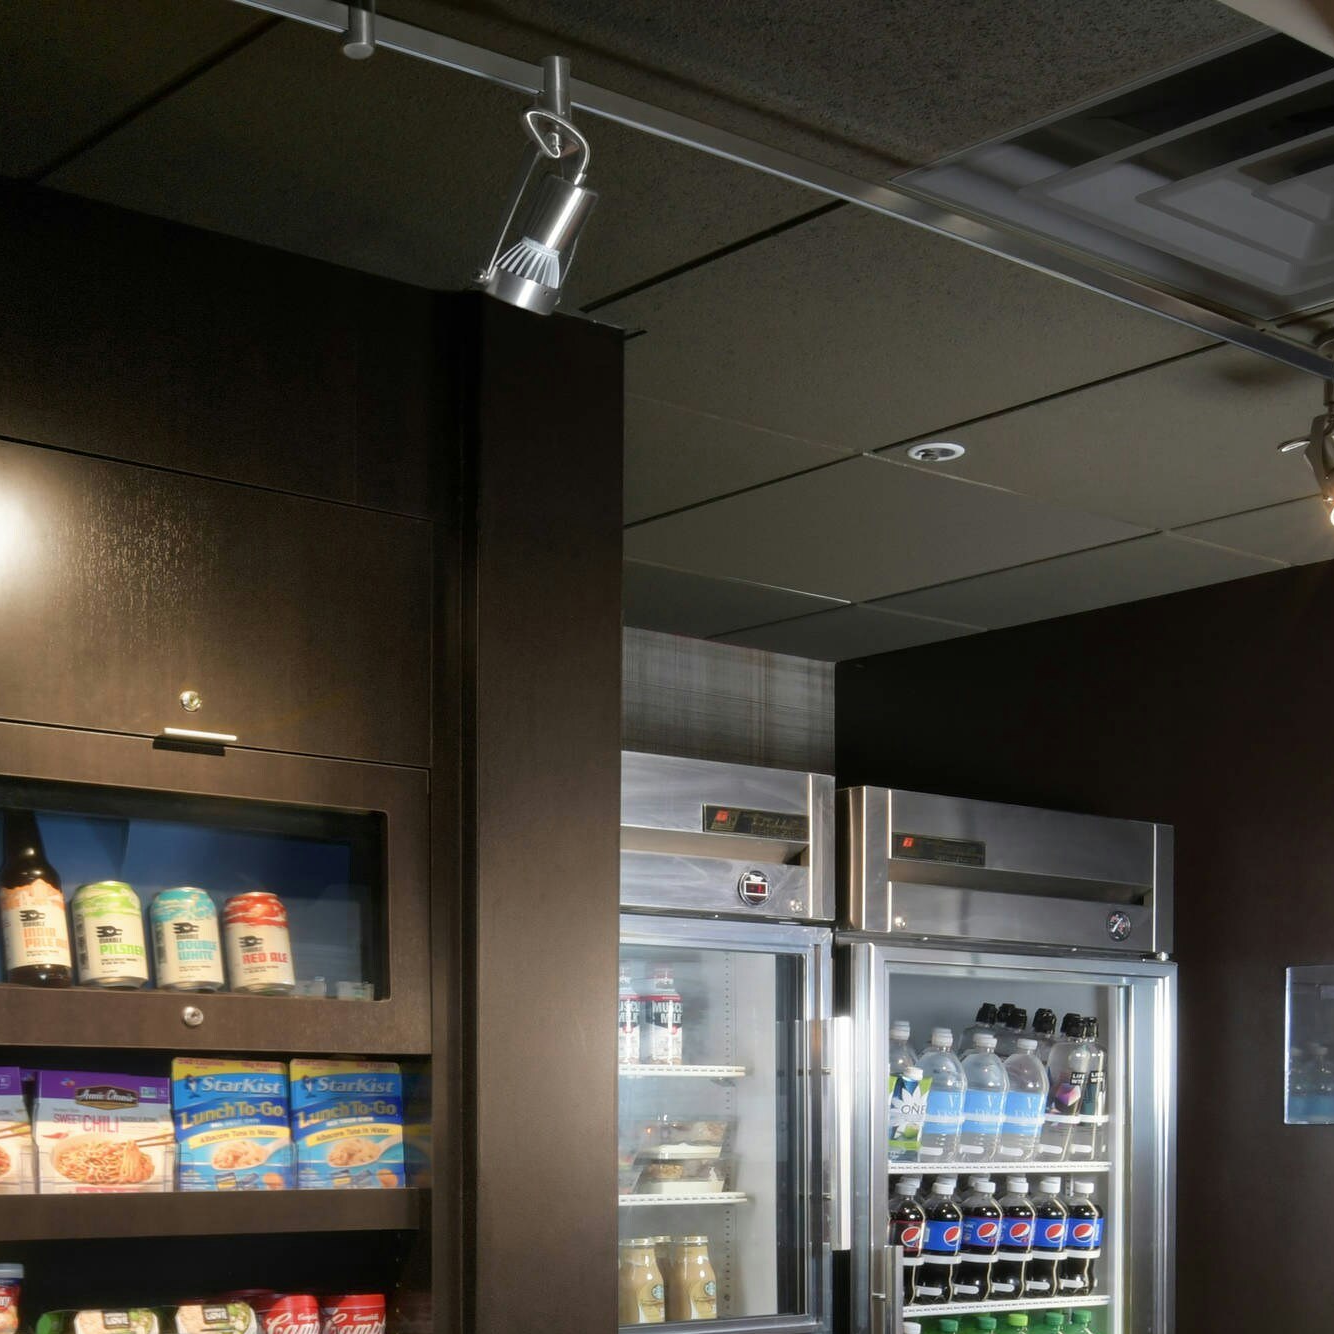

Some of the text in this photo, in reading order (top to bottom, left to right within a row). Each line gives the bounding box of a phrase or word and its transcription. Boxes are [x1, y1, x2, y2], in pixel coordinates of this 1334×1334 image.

[242, 952, 289, 965] RED ALE
[201, 1075, 283, 1096] StarKist
[316, 1077, 395, 1094] StarKist
[82, 1114, 120, 1133] CHILI
[178, 1101, 236, 1131] Lunch
[235, 1100, 285, 1118] To-Go
[296, 1101, 350, 1129] Lunch
